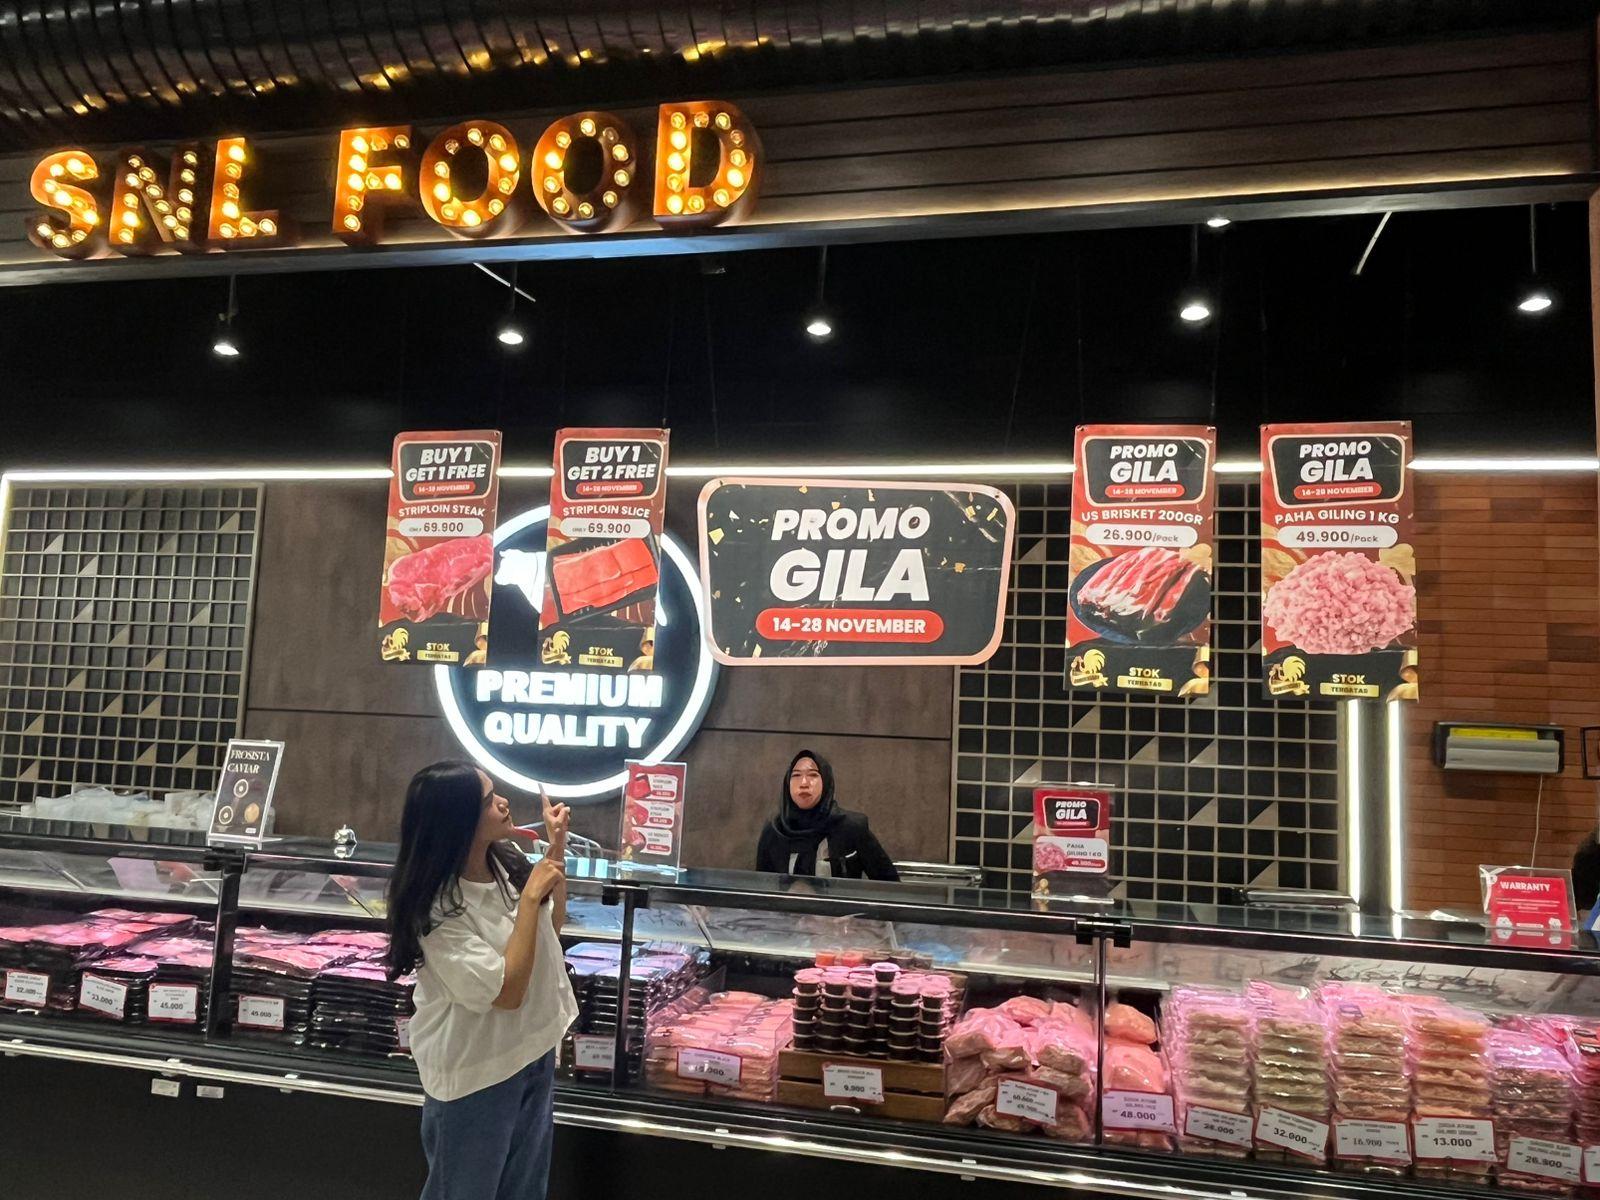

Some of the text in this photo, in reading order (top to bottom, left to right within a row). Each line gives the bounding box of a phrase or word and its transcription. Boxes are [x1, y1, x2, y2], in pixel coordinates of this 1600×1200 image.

[29, 100, 760, 250] SNL FOOD
[420, 446, 473, 466] BUY 1
[584, 445, 642, 464] BUY 1
[1109, 443, 1179, 459] PROMO
[1299, 440, 1372, 459] PROMO
[405, 463, 487, 482] GET 1 FREE
[567, 463, 657, 481] GET 2 FREE
[1109, 459, 1179, 484] GILA
[1299, 457, 1374, 483] GILA
[436, 484, 471, 492] NOVEMBER
[601, 484, 638, 492] NOVEMBER
[1134, 487, 1178, 495] NOVEMBER
[1301, 486, 1374, 496] 14-28 NOVEMBER
[398, 504, 486, 517] STRIPLOIN STEAK
[562, 504, 651, 518] STRIPLOIN SLICE
[1081, 509, 1204, 525] US BRISKET 200GR
[1274, 509, 1400, 525] PAHA GILING 1 KG
[423, 522, 464, 533] 69.900
[588, 522, 631, 533] 69.900
[770, 506, 931, 542] PROMO
[1103, 528, 1179, 543] 26.900/Pack
[1296, 530, 1379, 544] 49.900/Pack
[769, 547, 931, 602] GILA
[773, 616, 927, 635] 14-28 NOVEMBER
[426, 642, 450, 652] STOK
[588, 646, 614, 656] STOK
[1129, 666, 1161, 679] STOK
[1332, 673, 1366, 685] STOK
[475, 669, 664, 708] PREMIUM
[483, 710, 652, 749] QUALITY
[230, 749, 271, 762] FROSISTA
[227, 763, 261, 774] CAVIAR
[1055, 800, 1088, 809] PROMO
[1055, 808, 1088, 820] GILA
[1499, 880, 1551, 893] WARRANTY
[1119, 1110, 1157, 1121] 48.000
[1273, 1127, 1308, 1144] 32.000
[1432, 1137, 1473, 1147] 13.000
